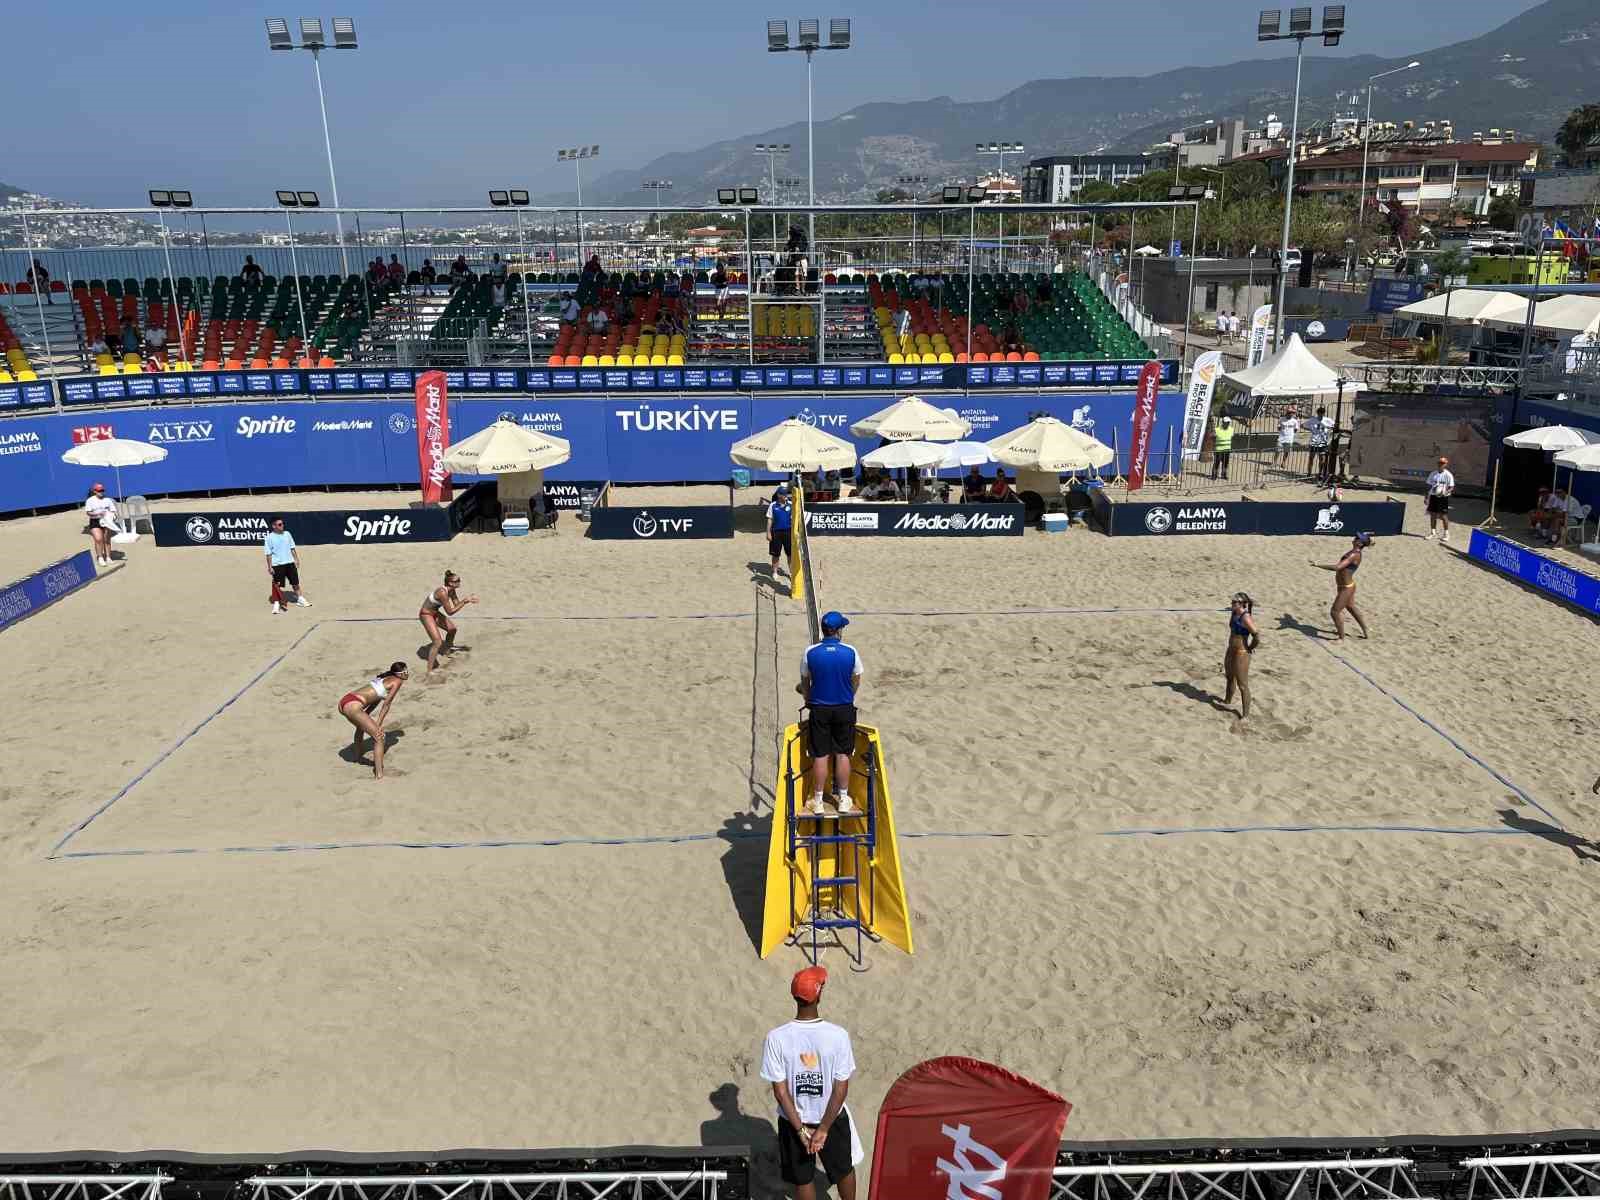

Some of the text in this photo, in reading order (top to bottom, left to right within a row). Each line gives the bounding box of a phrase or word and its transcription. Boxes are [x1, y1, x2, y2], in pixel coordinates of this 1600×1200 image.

[522, 412, 562, 421] ALANYA
[615, 404, 739, 431] TÜRKİYE
[818, 415, 848, 426] TVF
[149, 424, 213, 440] ALTAV
[236, 415, 297, 438] Sprite
[0, 432, 40, 444] LANYA
[0, 442, 42, 455] ELEDİYESİ
[491, 463, 517, 471] ALANYA
[543, 485, 579, 496] LANYA
[812, 515, 846, 523] BEACH
[1177, 508, 1227, 519] ALANYA
[218, 517, 269, 529] ALANYA
[343, 514, 412, 540] Sprite
[660, 519, 693, 533] TVF
[1176, 520, 1227, 531] BELEDİYESİ
[796, 1072, 824, 1081] BEACH
